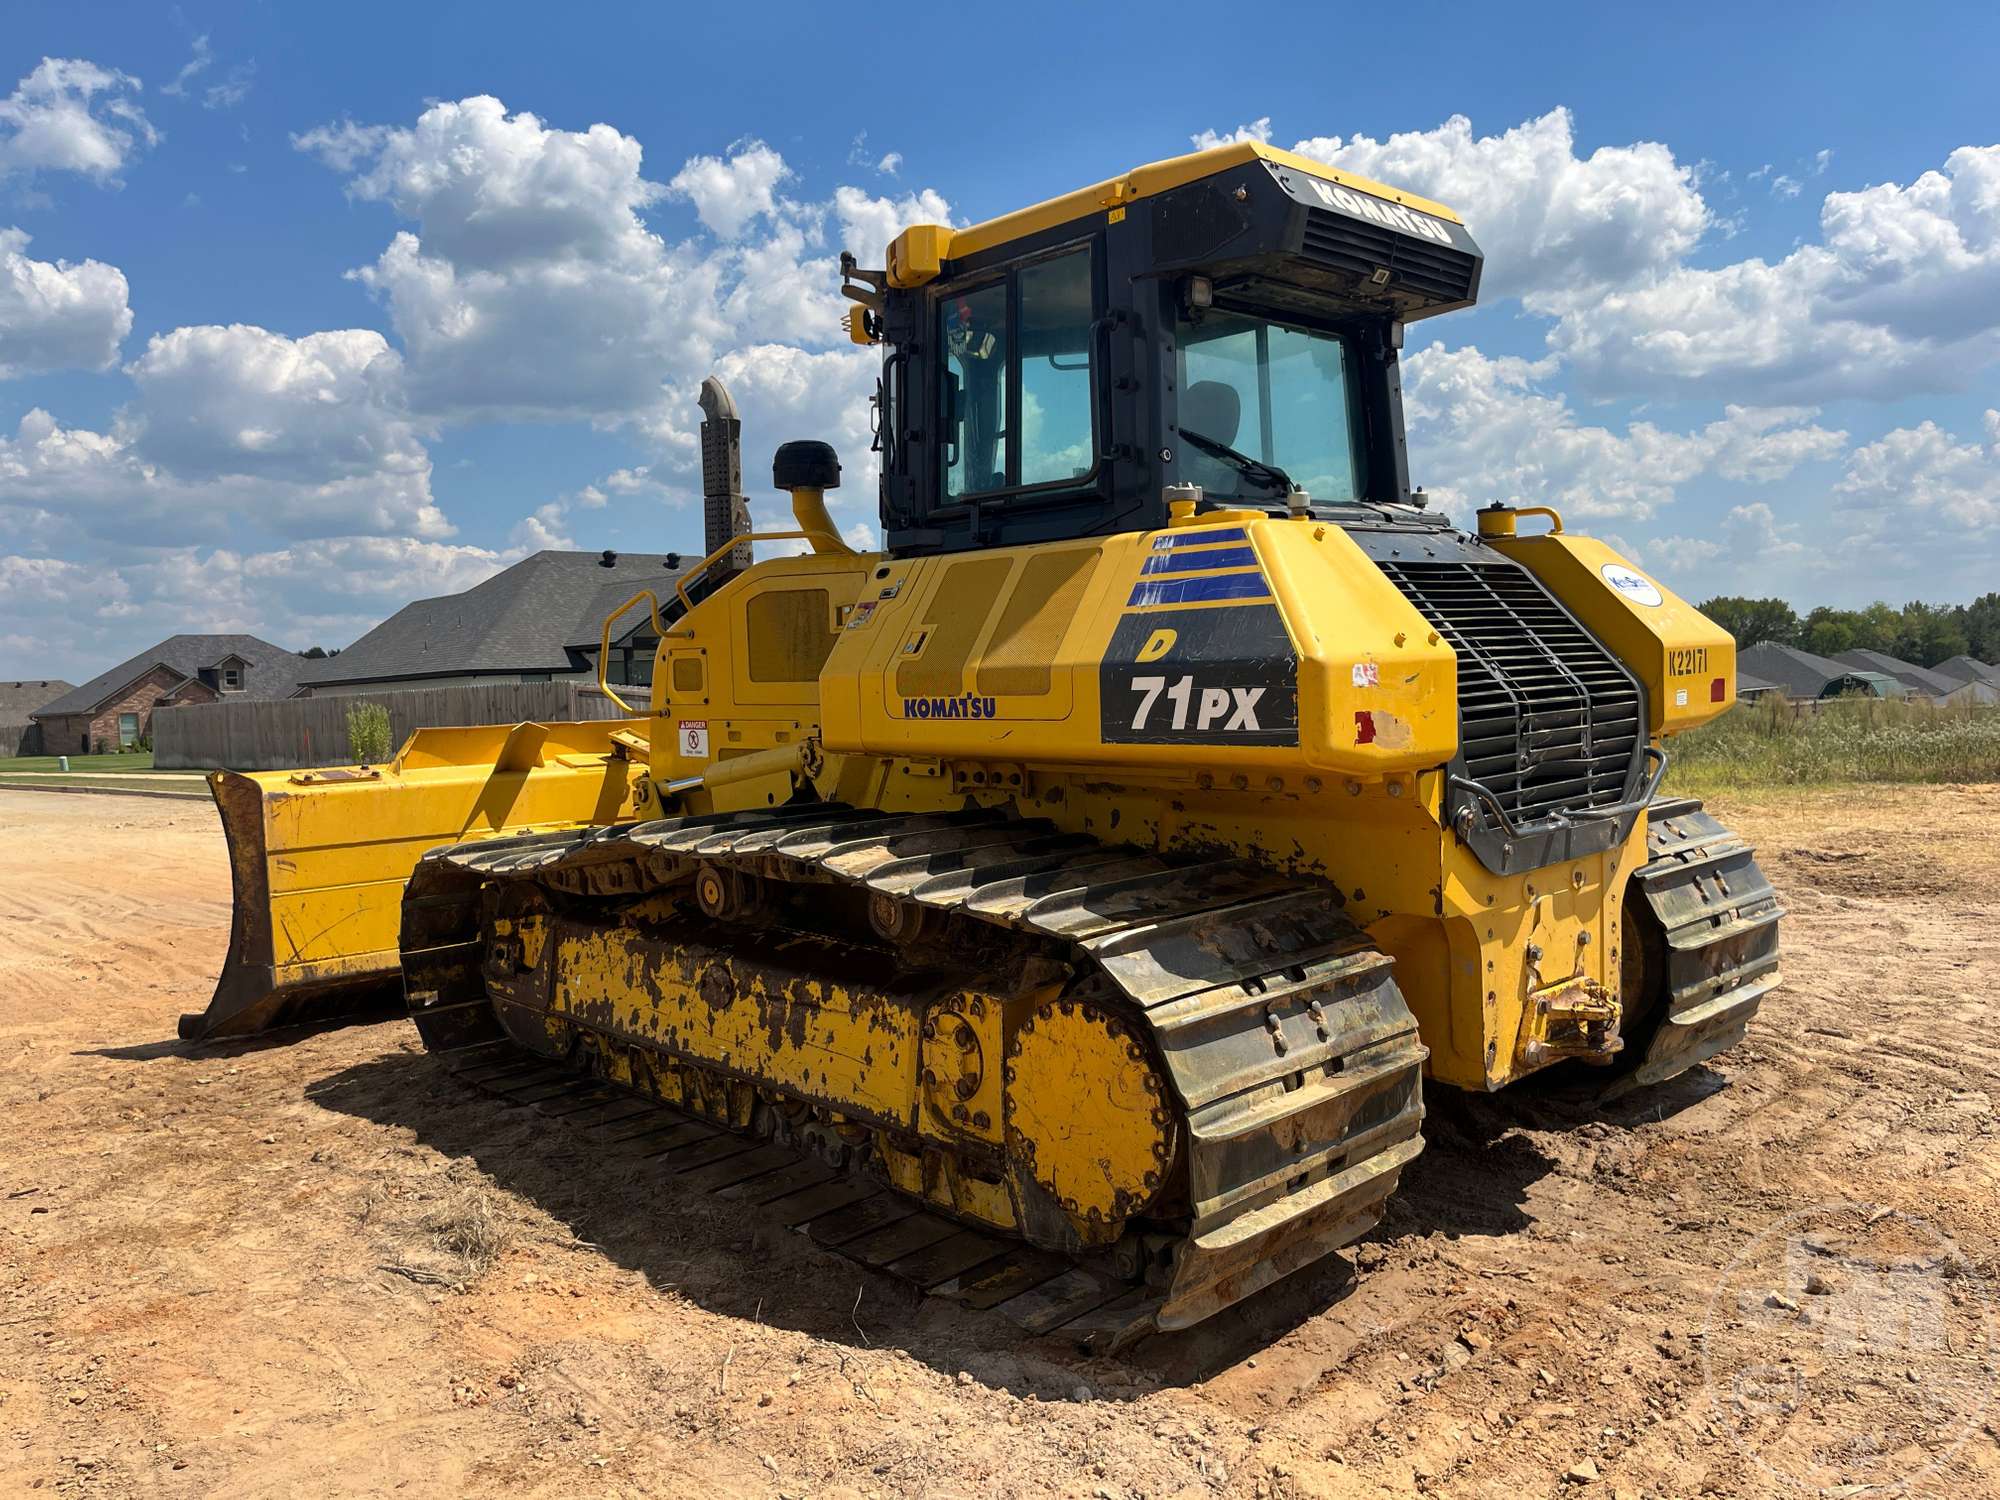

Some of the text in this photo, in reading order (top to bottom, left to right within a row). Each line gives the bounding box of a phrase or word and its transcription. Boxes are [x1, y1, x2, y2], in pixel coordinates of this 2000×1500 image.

[1308, 179, 1452, 243] KOMATSU
[1135, 629, 1177, 663] D
[1669, 648, 1707, 676] K22171
[904, 692, 996, 718] KOMATSU
[685, 721, 706, 729] DANGER
